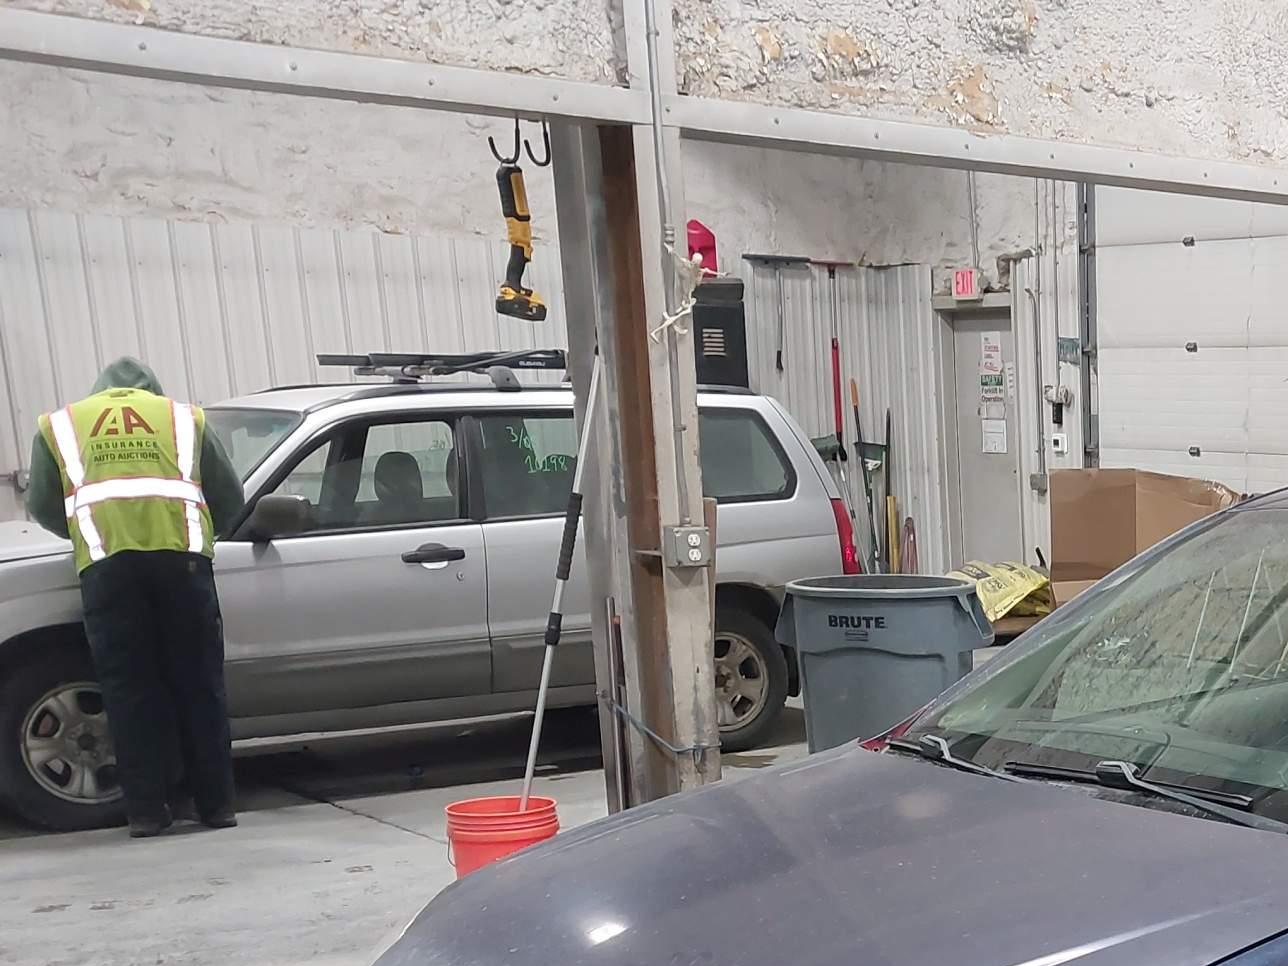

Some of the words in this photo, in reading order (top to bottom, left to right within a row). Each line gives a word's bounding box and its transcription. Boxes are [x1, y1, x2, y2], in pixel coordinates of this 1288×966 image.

[956, 270, 973, 295] EXIT
[91, 440, 159, 451] INSURANCE
[94, 453, 116, 463] AUTO
[117, 451, 160, 462] AUCTIONS
[828, 615, 886, 629] BRUTE
